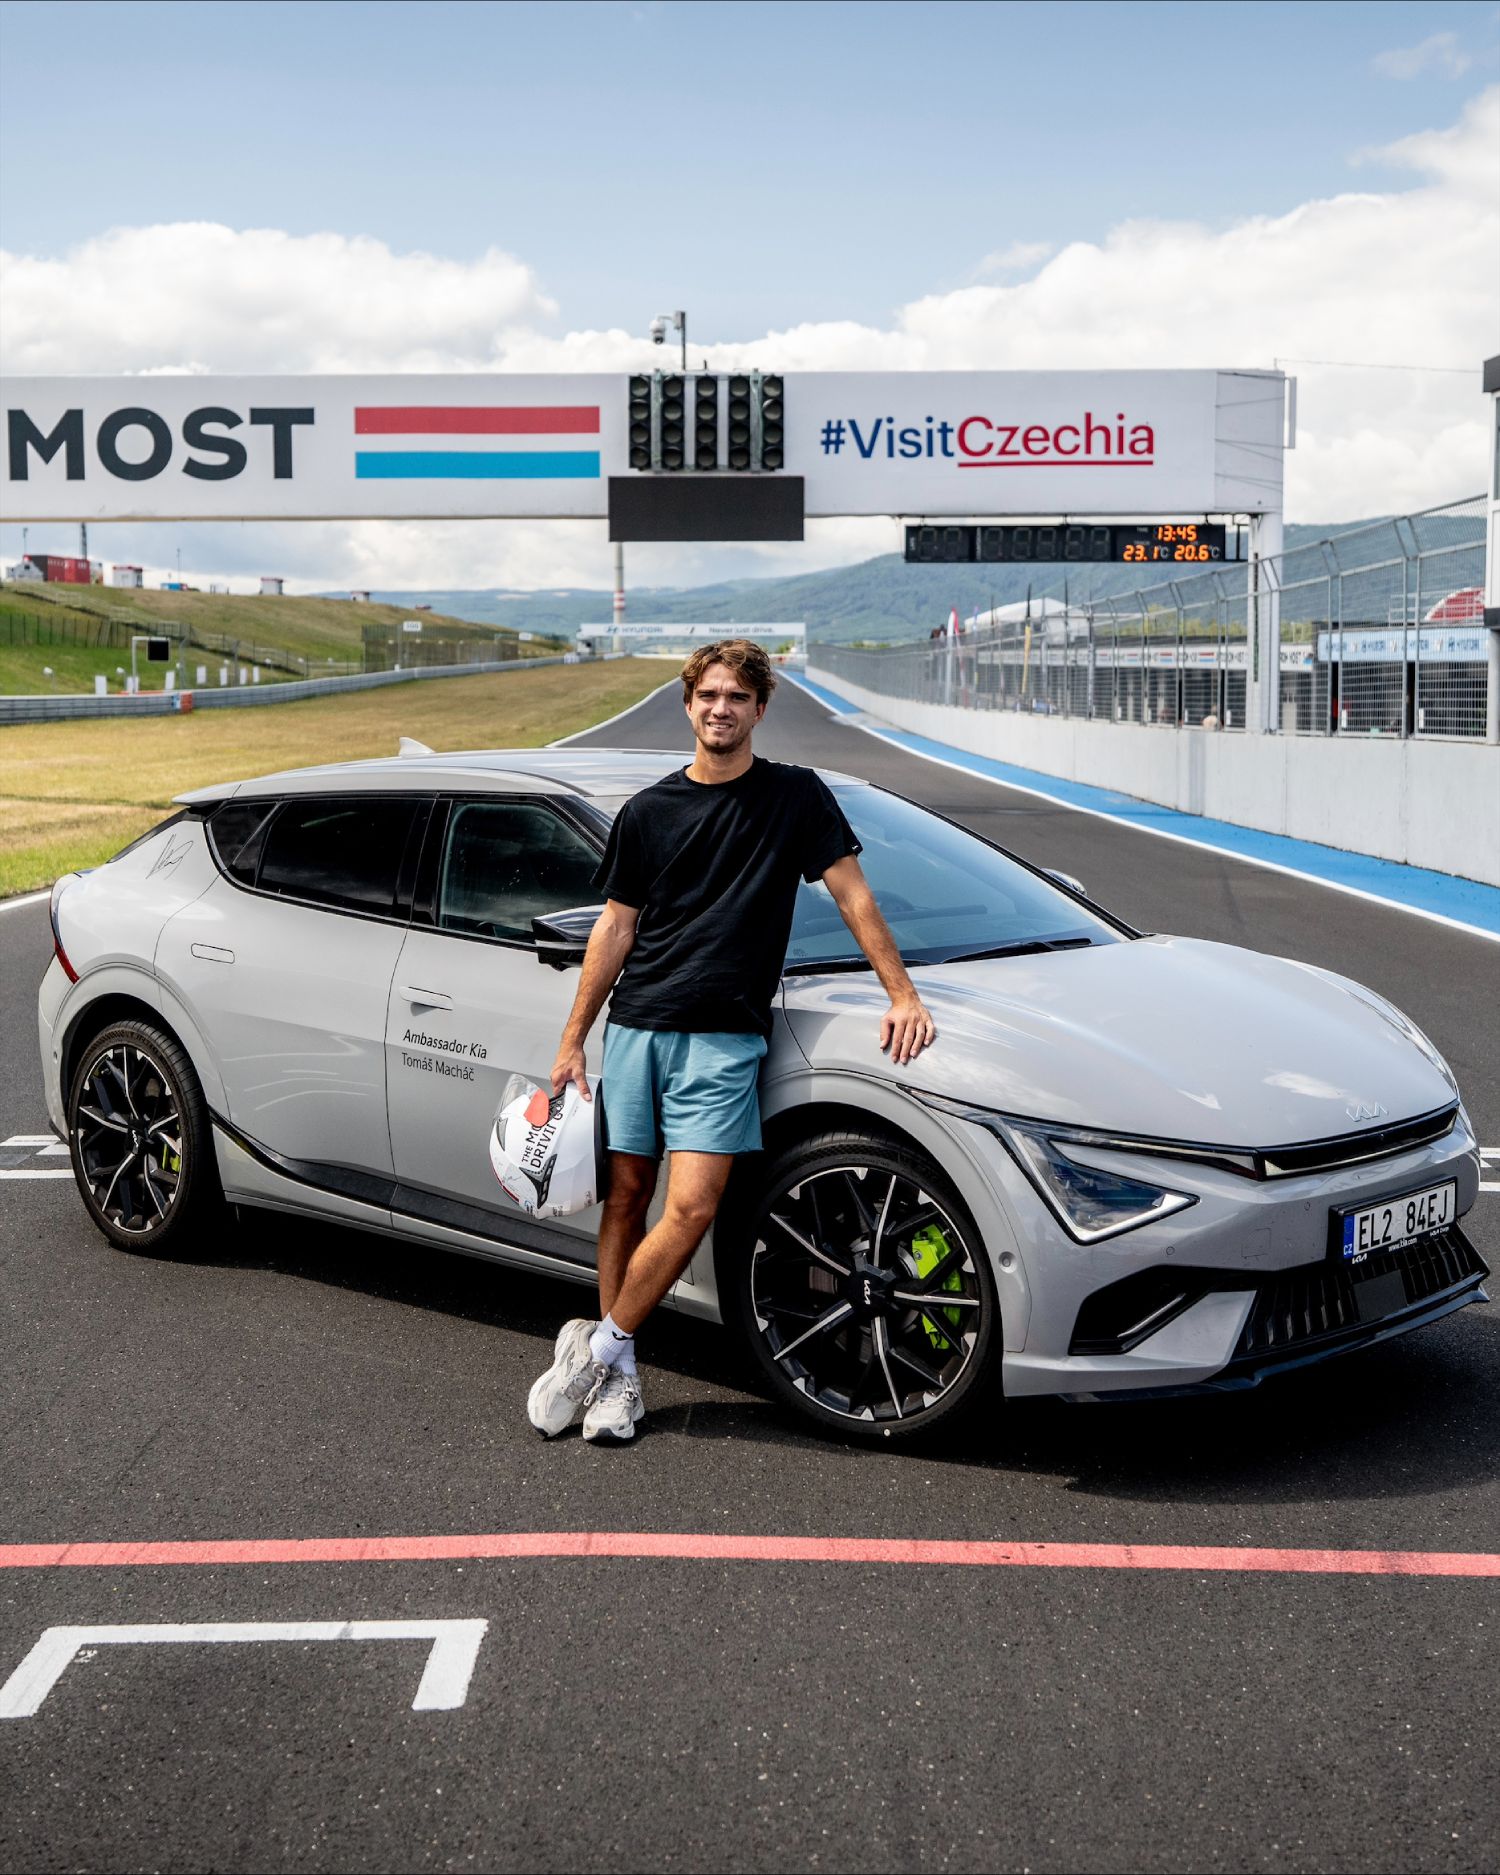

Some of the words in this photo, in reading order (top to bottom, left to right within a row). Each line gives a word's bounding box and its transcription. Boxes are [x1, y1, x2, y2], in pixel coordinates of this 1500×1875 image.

[7, 406, 315, 481] MOST
[820, 412, 1154, 460] #VisitCzechia
[1157, 524, 1198, 541] 13:45
[403, 1028, 468, 1054] Ambassador
[469, 1042, 487, 1059] Kia
[401, 1052, 433, 1072] Tomáš
[435, 1060, 475, 1081] Macháč
[521, 1144, 534, 1163] THE
[1358, 1208, 1392, 1251] EL2
[1405, 1189, 1448, 1235] 84EJ
[1343, 1243, 1353, 1256] CZ
